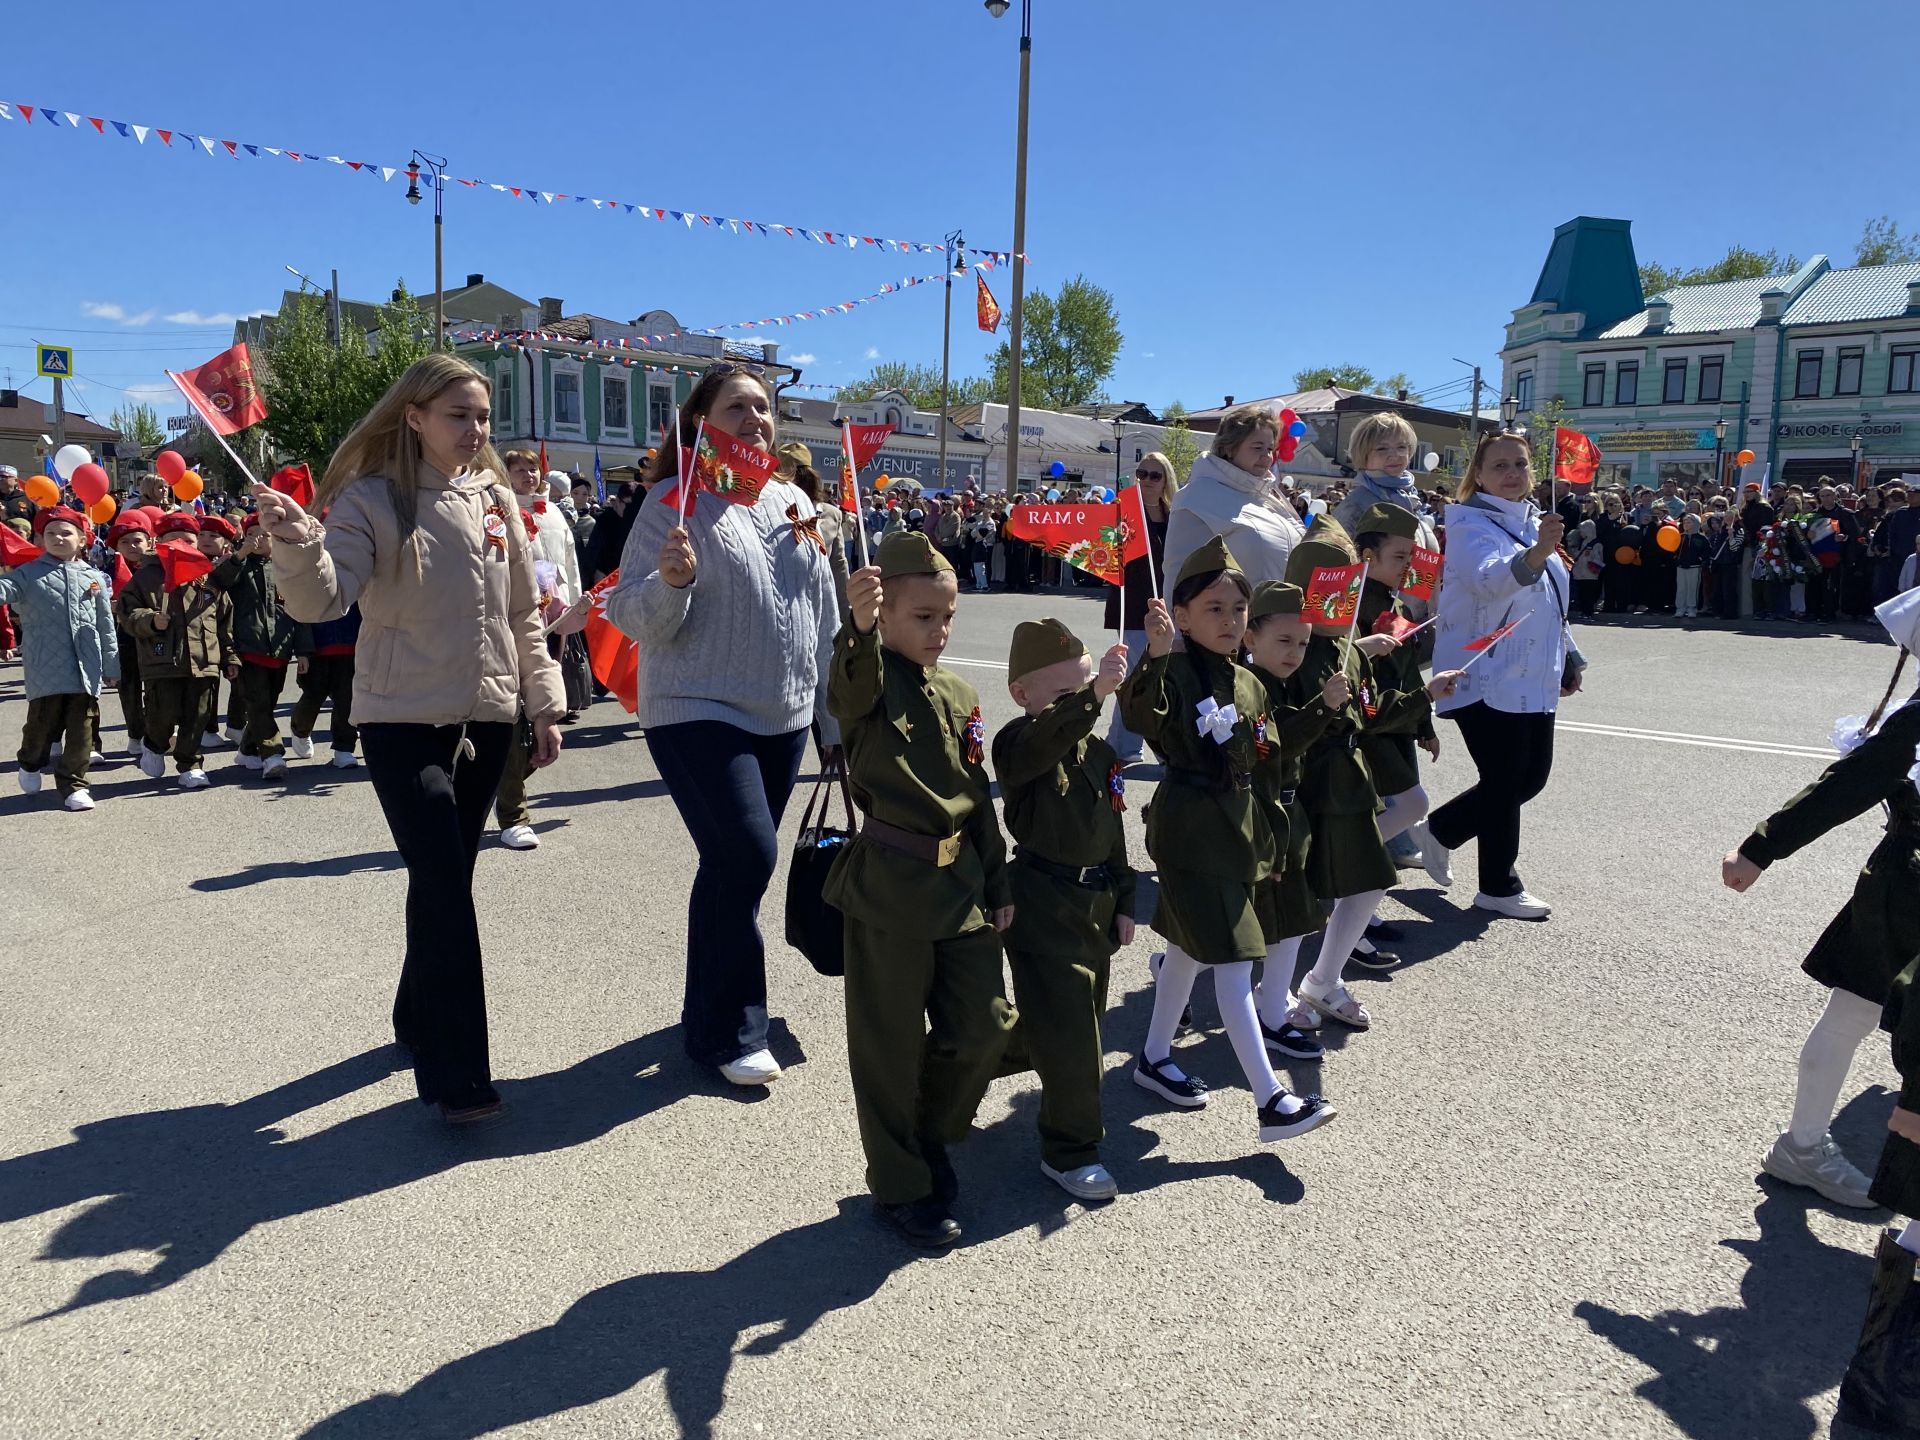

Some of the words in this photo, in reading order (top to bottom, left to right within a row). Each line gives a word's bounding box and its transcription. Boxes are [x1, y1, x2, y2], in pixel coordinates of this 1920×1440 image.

[1795, 424, 1840, 437] КОФЕ
[730, 443, 739, 454] 9
[739, 448, 771, 470] МАЯ
[823, 456, 841, 468] caf
[861, 456, 923, 477] AVENUE
[1419, 552, 1440, 565] МАЯ
